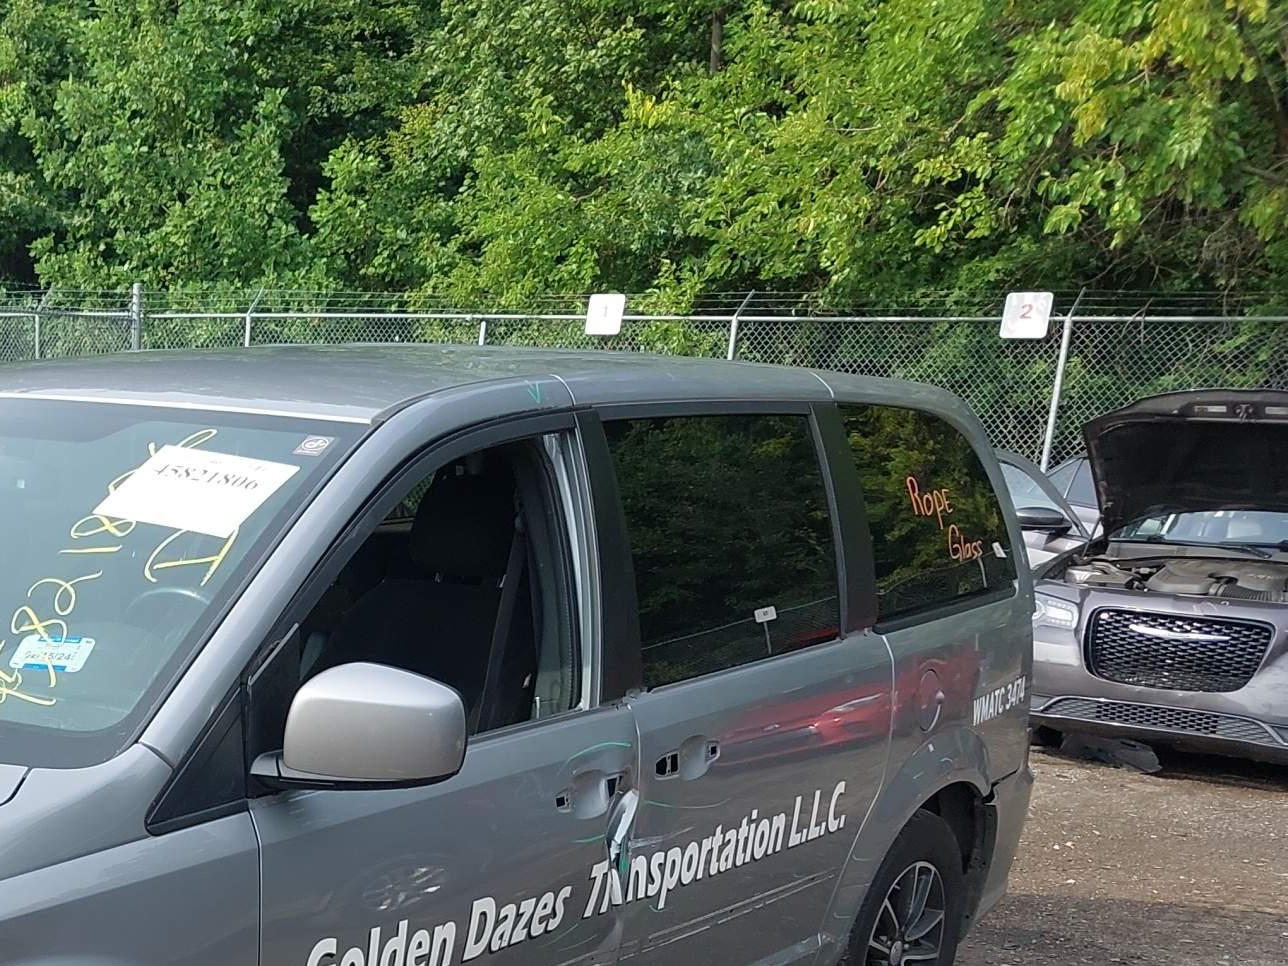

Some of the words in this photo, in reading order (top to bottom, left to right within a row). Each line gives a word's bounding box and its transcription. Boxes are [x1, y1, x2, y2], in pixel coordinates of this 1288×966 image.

[1019, 303, 1033, 319] 2
[155, 464, 259, 489] 45821806
[972, 686, 1005, 727] WMATC
[1005, 674, 1026, 710] 3474
[462, 885, 572, 963] Dazes
[787, 780, 847, 848] L.L.C.
